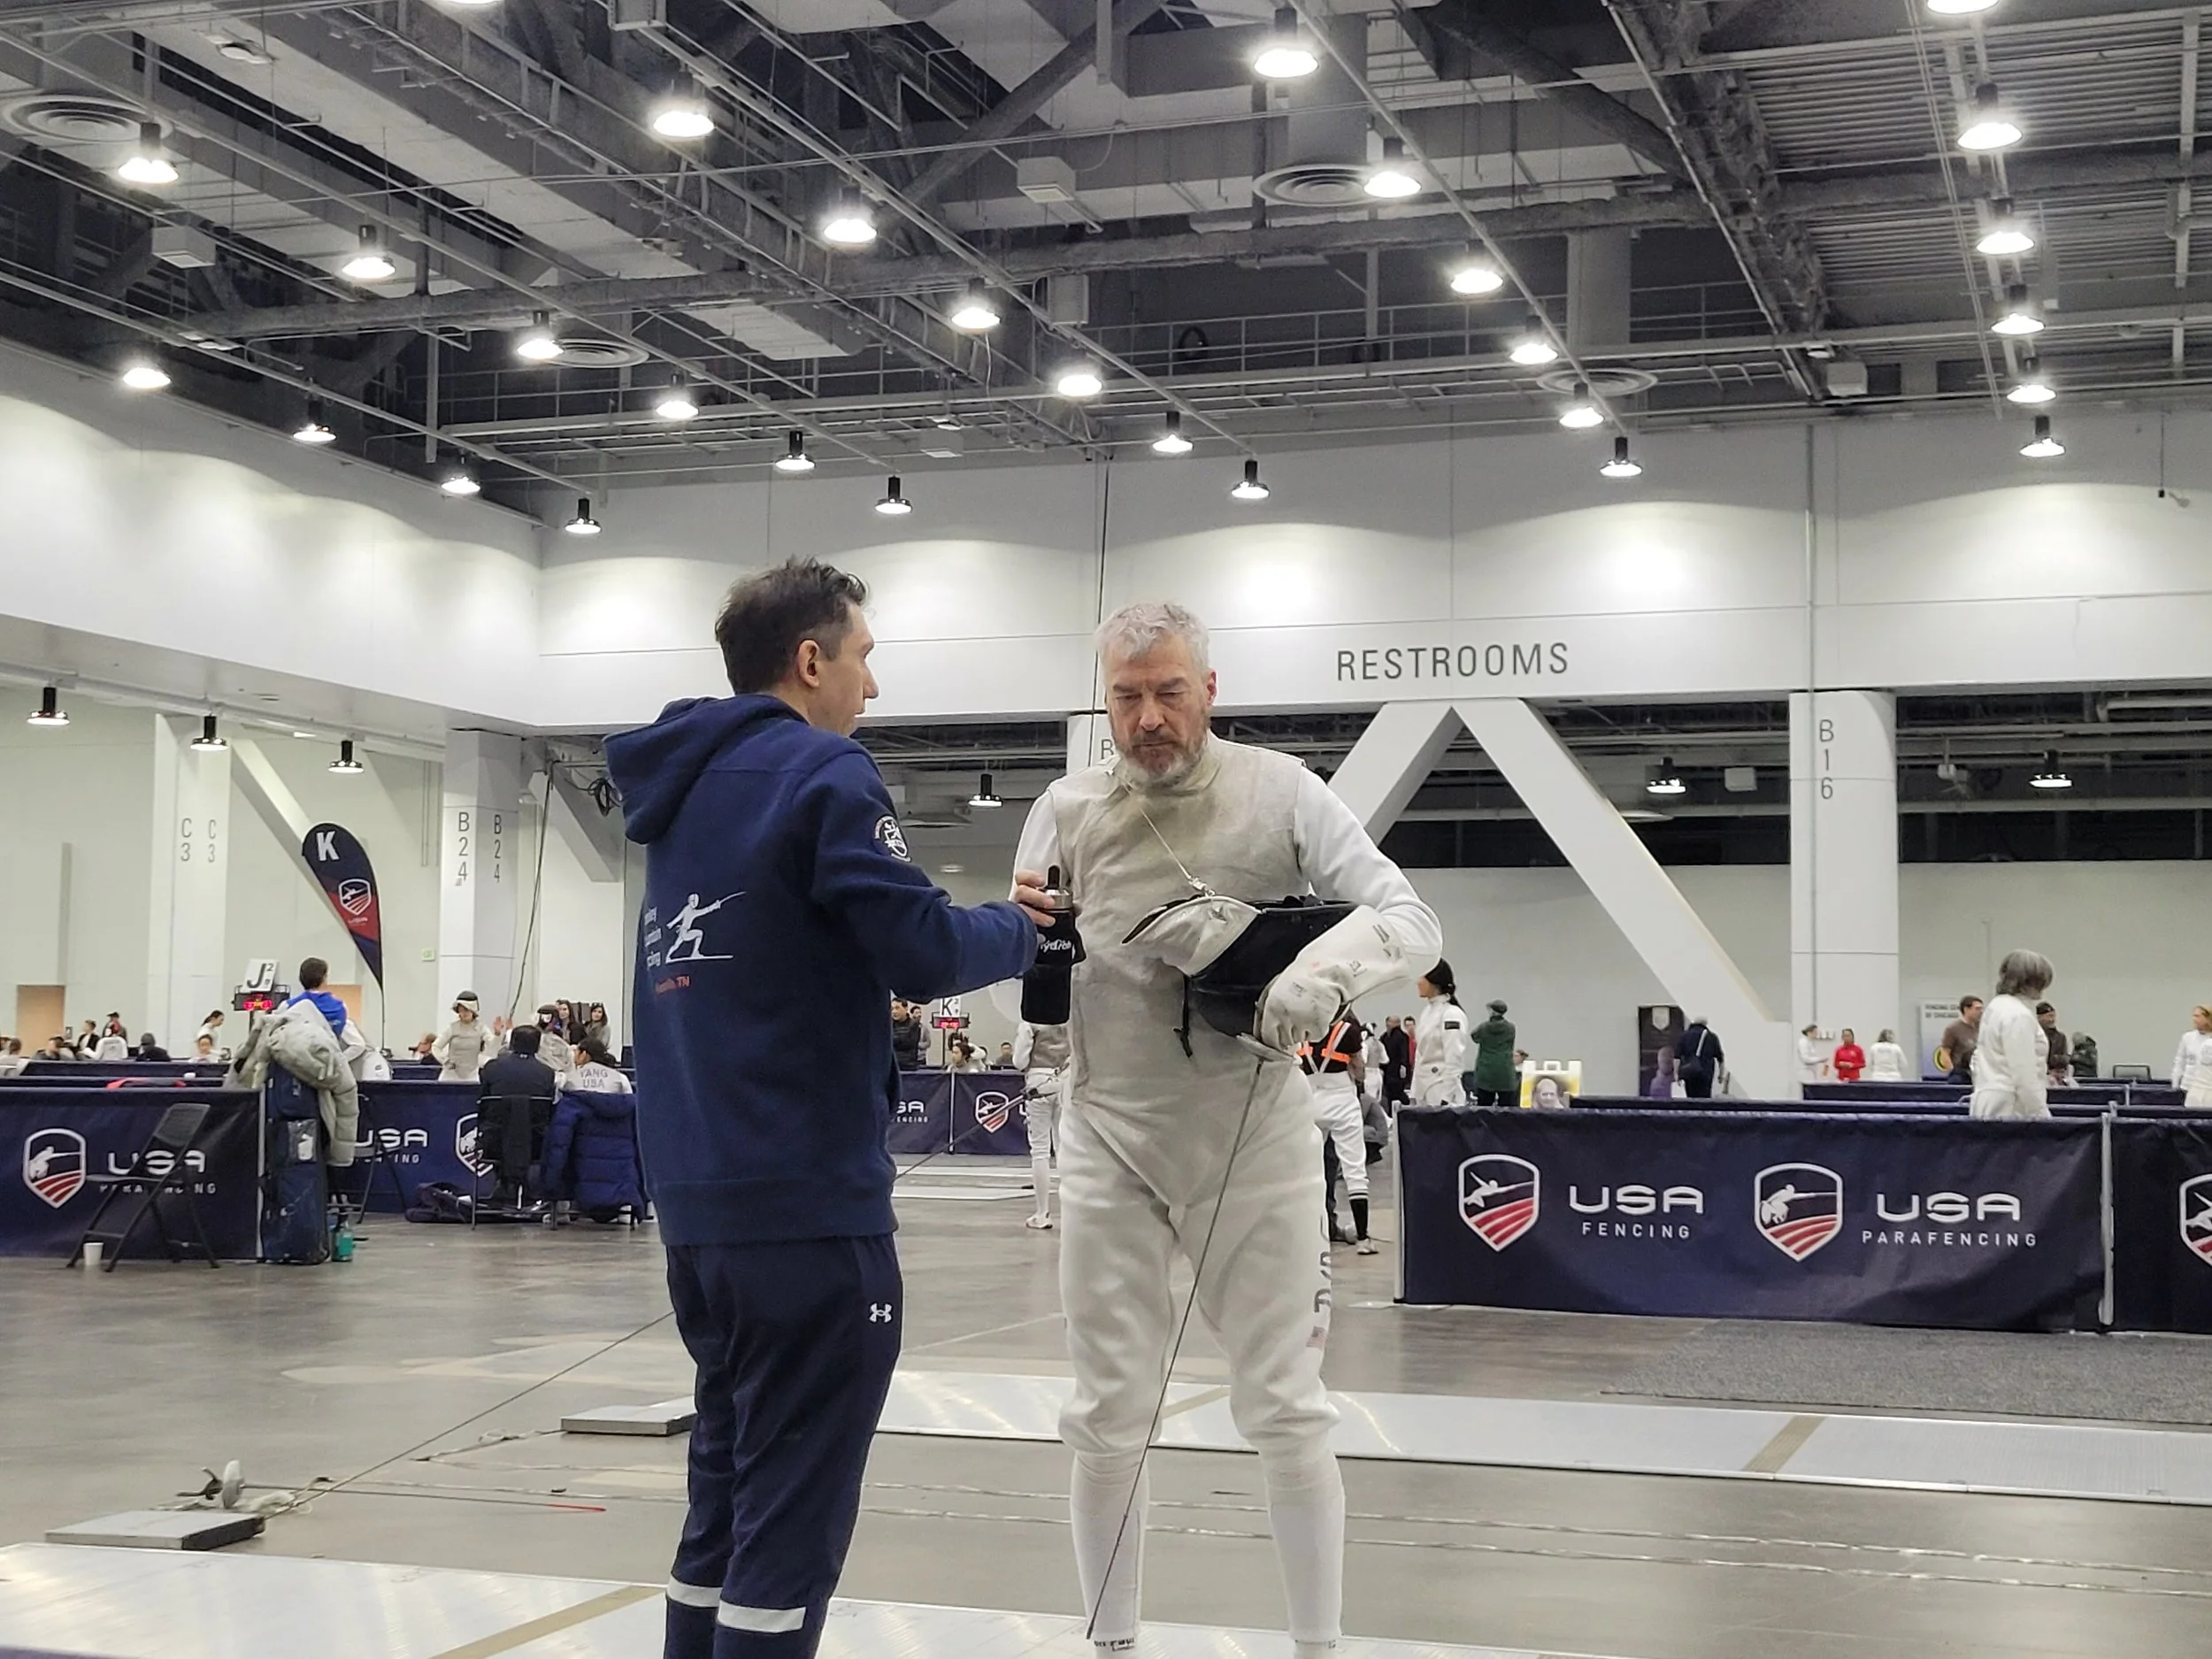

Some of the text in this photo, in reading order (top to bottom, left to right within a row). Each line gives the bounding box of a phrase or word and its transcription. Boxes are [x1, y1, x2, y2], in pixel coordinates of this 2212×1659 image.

[1337, 642, 1568, 680] RESTROOMS
[1819, 718, 1834, 800] B16
[317, 831, 340, 862] K
[457, 811, 470, 881] B24
[108, 1150, 205, 1176] USA
[1569, 1185, 1703, 1216] USA
[1877, 1192, 2021, 1224] USA
[1582, 1221, 1690, 1239] FENCING
[1862, 1230, 2037, 1247] PARAFENCING
